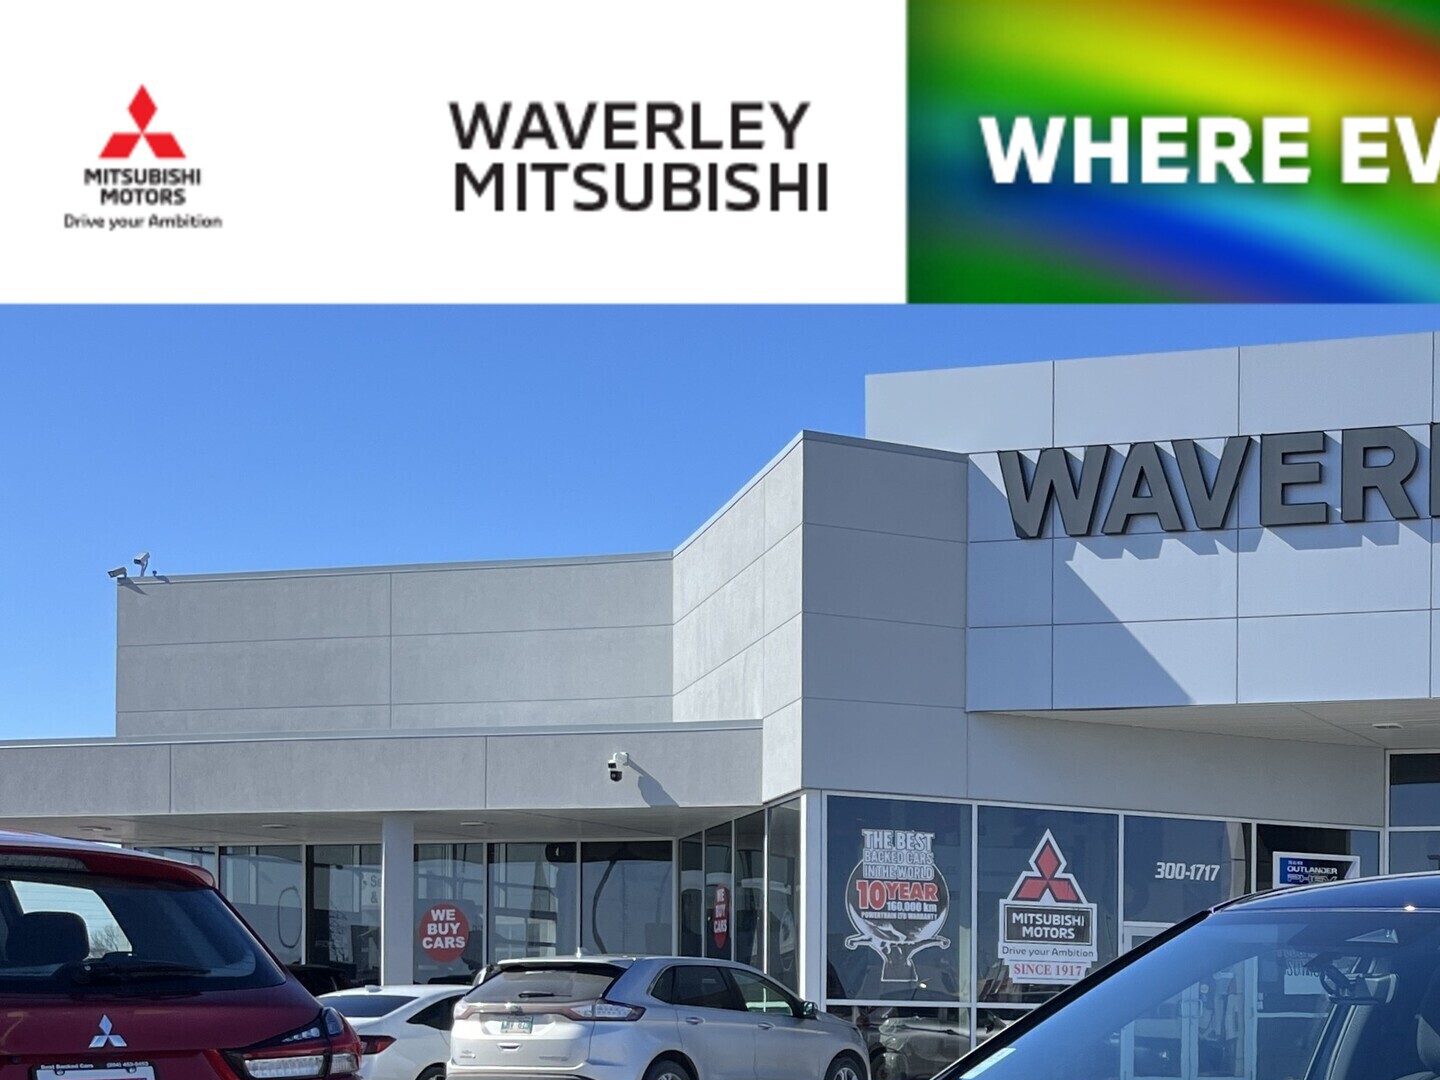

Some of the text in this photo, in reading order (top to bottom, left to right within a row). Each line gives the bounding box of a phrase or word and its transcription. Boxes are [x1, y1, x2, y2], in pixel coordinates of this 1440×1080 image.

[861, 829, 935, 852] THE BEST
[863, 850, 934, 865] BACKED CARS
[876, 864, 896, 879] THE
[897, 865, 934, 880] WORLD
[1154, 862, 1220, 882] 300-1717
[1286, 866, 1338, 875] OUTLANDER
[856, 880, 938, 910] 10 YEAR
[923, 902, 937, 912] km
[430, 908, 456, 922] WE
[1012, 912, 1084, 926] MITSUBISHI
[427, 922, 460, 936] BUY
[1022, 926, 1076, 940] MOTORS
[422, 936, 466, 950] CARS
[1002, 946, 1094, 958] Drive your Ambition
[1014, 964, 1082, 977] SINCE 1917
